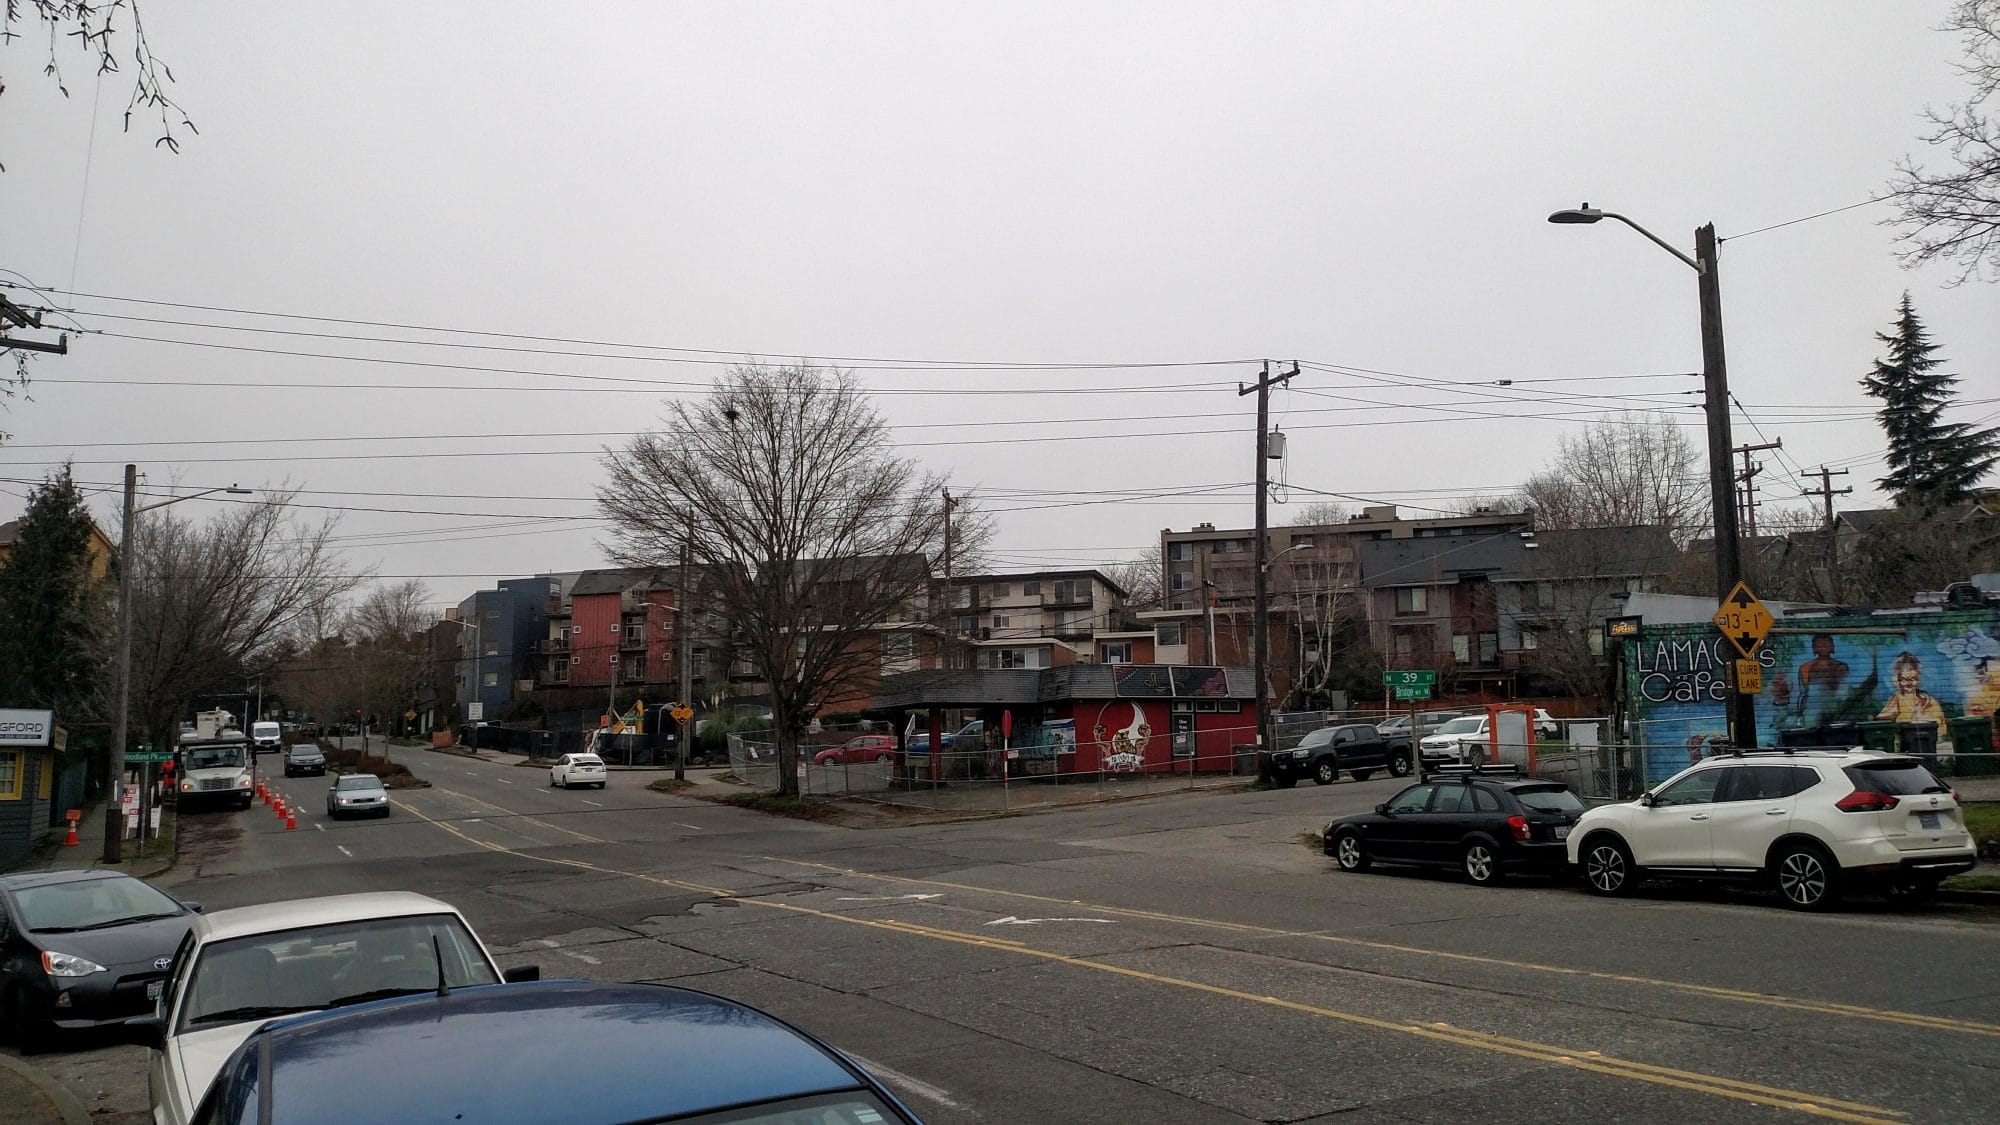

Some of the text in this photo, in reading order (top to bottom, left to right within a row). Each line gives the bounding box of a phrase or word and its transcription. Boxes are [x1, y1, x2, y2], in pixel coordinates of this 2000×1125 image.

[1740, 664, 1759, 675] CURB
[1402, 672, 1418, 683] 39
[1741, 678, 1759, 689] LANE
[1396, 687, 1414, 697] Bridge
[0, 722, 44, 732] GFORD
